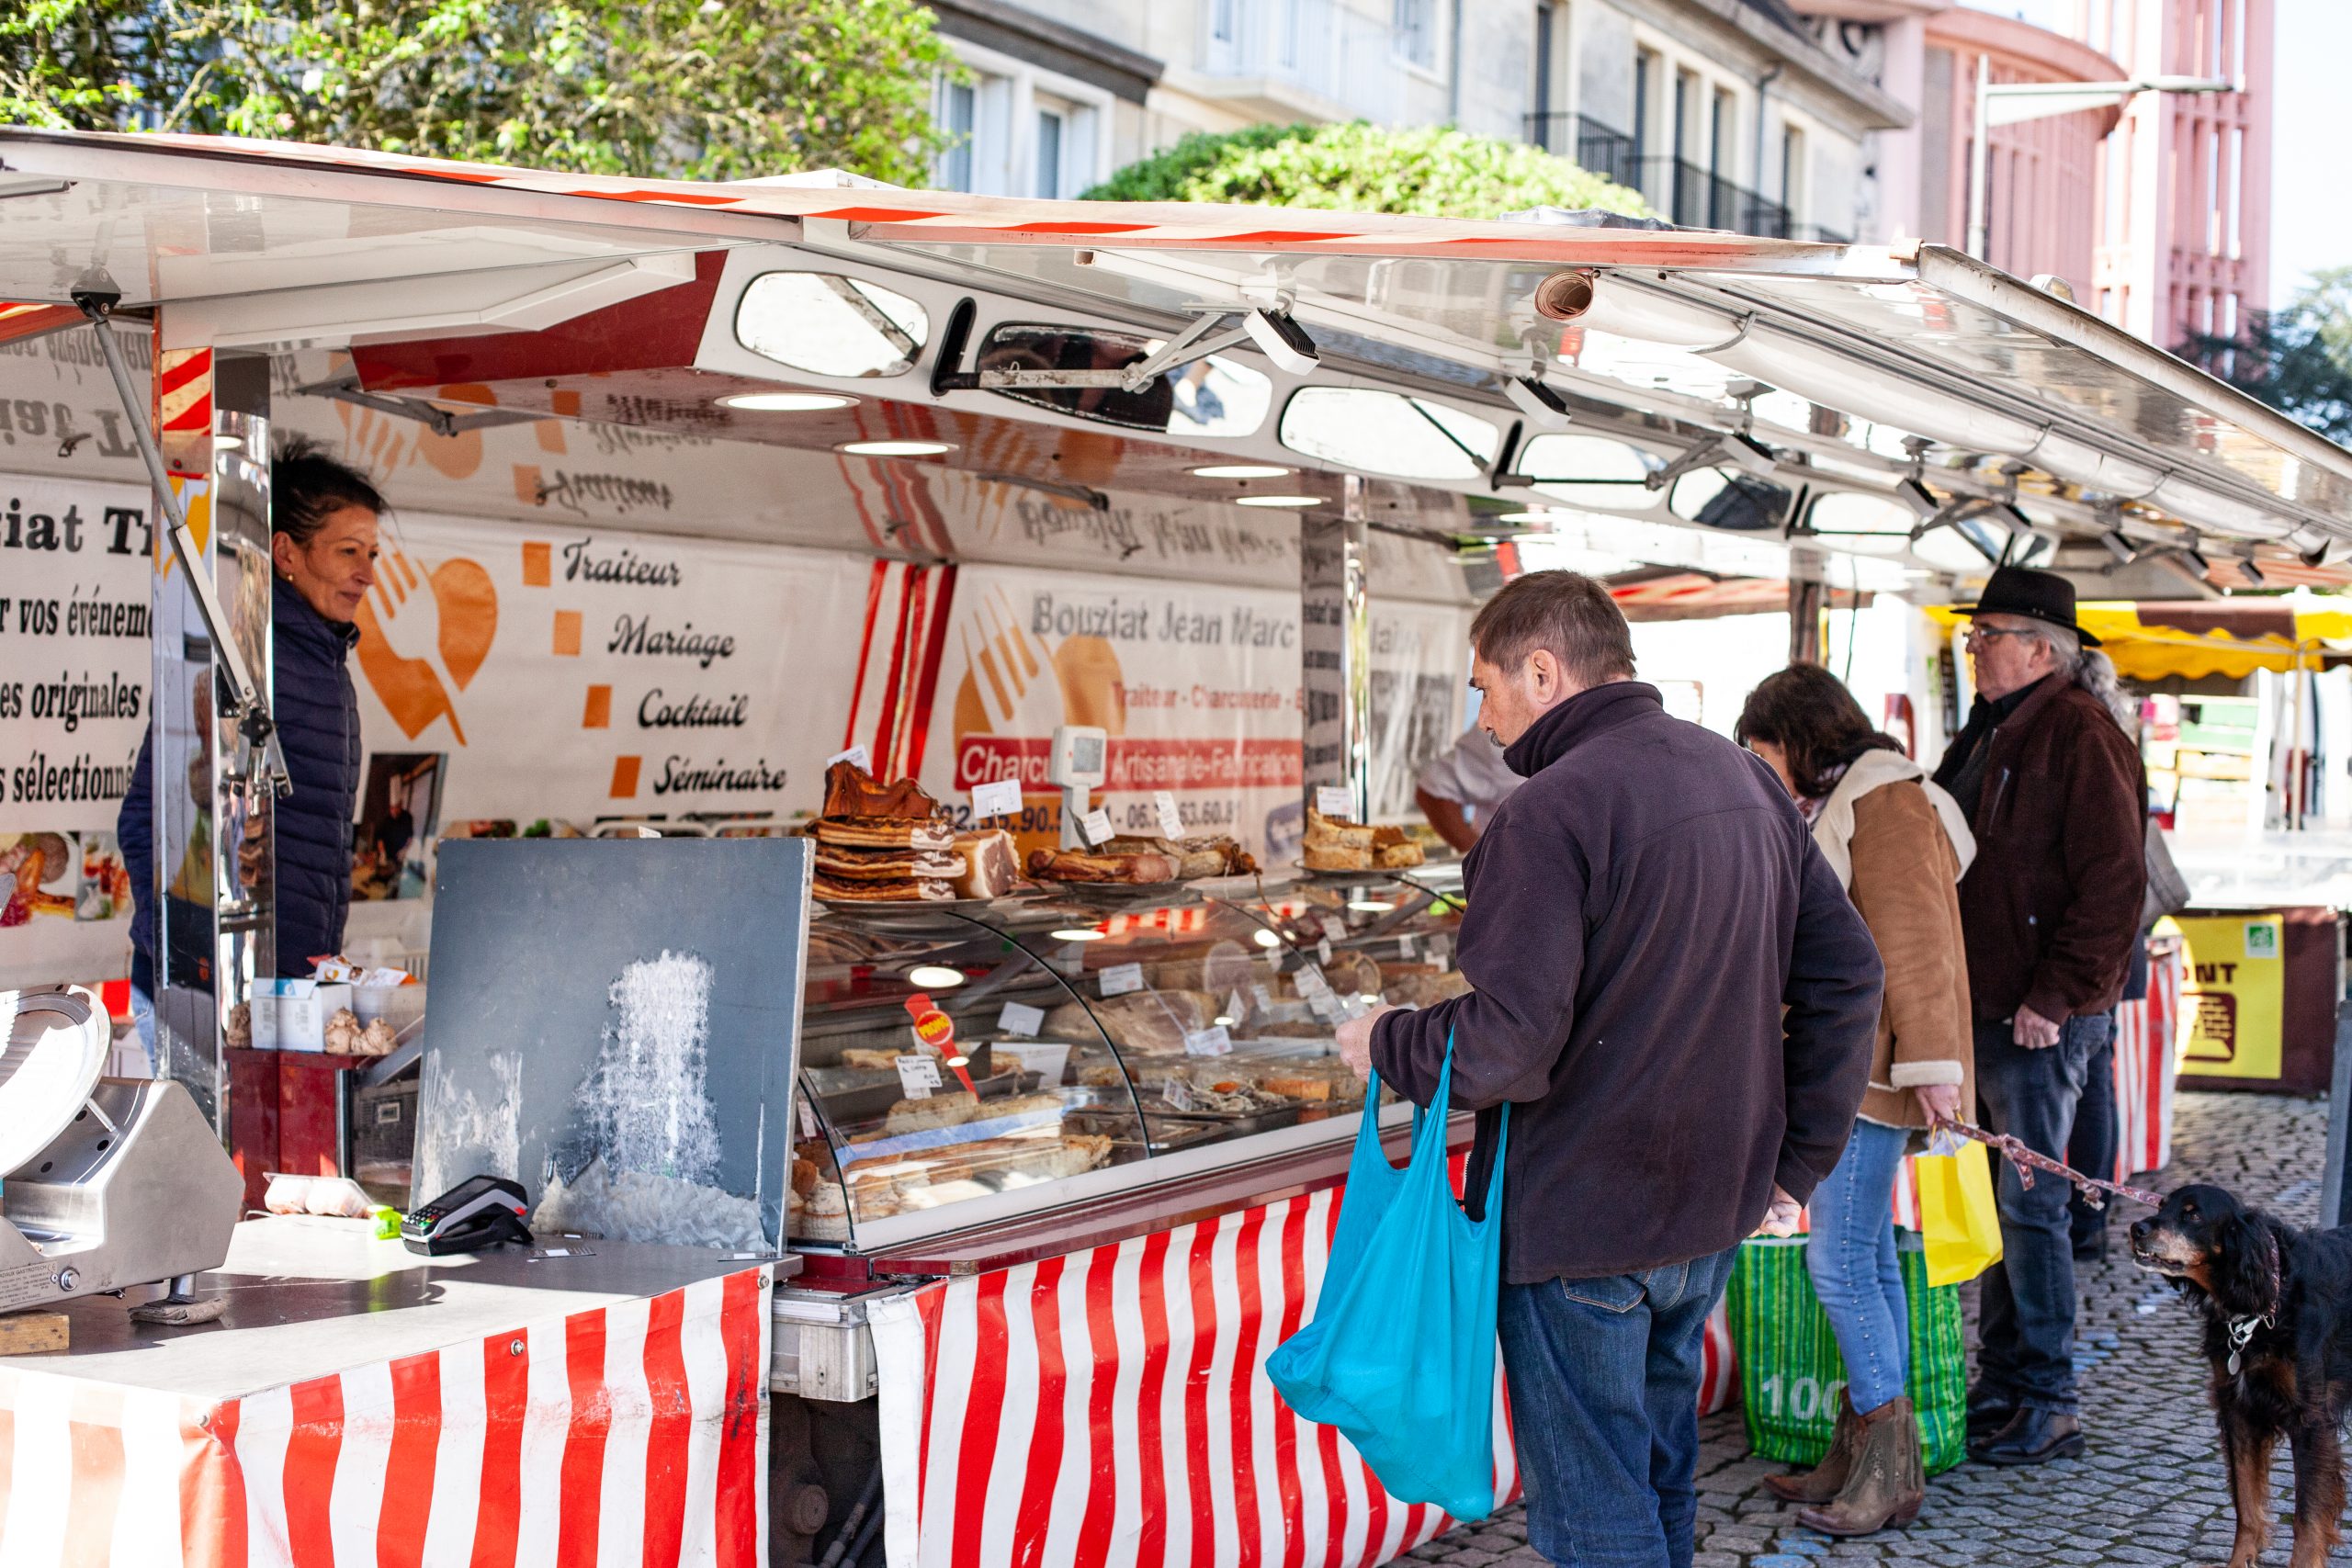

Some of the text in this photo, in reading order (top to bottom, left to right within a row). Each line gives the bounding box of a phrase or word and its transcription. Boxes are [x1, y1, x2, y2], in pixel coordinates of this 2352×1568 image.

[0, 498, 84, 552] iat
[563, 536, 683, 586] Traiteur
[19, 598, 59, 636] vos
[67, 583, 152, 638] événem
[1031, 595, 1148, 641] Bouziat
[1159, 600, 1224, 645] Jean
[1231, 604, 1295, 649] Marc
[607, 614, 736, 669] Mariage
[31, 670, 141, 732] originales
[638, 688, 749, 728] Cocktail
[653, 754, 788, 795] Séminaire
